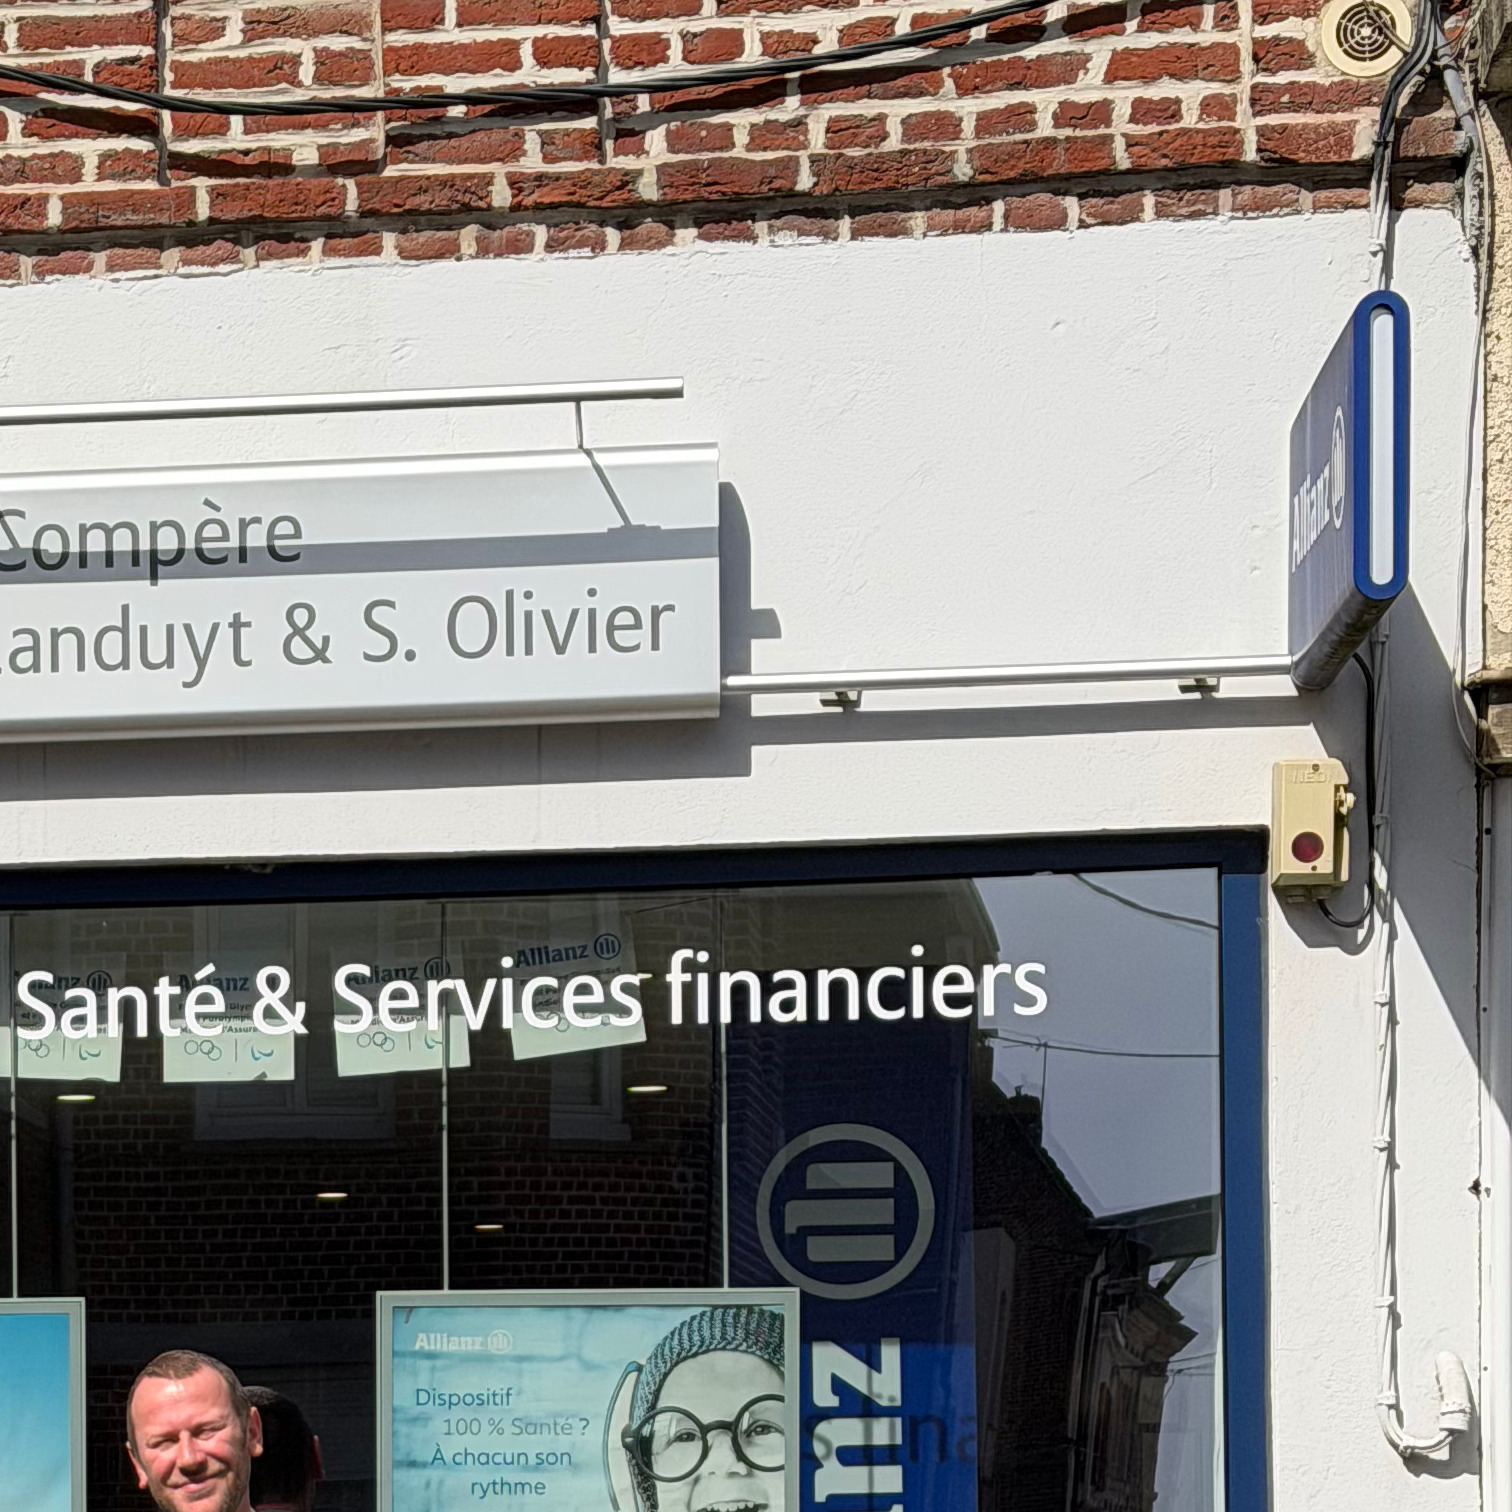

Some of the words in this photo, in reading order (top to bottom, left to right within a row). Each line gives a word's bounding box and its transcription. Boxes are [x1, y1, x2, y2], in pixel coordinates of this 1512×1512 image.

[1292, 459, 1330, 573] Allianz
[283, 607, 332, 667] &
[363, 598, 417, 663] S.
[447, 588, 676, 660] Olivier
[515, 945, 590, 968] Allianz
[17, 962, 226, 1040] Santé
[253, 965, 308, 1036] &
[333, 955, 642, 1034] Services
[667, 944, 1048, 1025] financiers
[414, 1332, 482, 1351] Allianz
[416, 1387, 513, 1410] Dispositif
[443, 1417, 481, 1436] 100
[487, 1417, 505, 1436] %
[511, 1417, 573, 1437] Santé
[578, 1417, 590, 1436] ?
[431, 1443, 446, 1466] À
[452, 1447, 530, 1467] chacun
[535, 1451, 572, 1467] son
[471, 1476, 546, 1499] rythme
